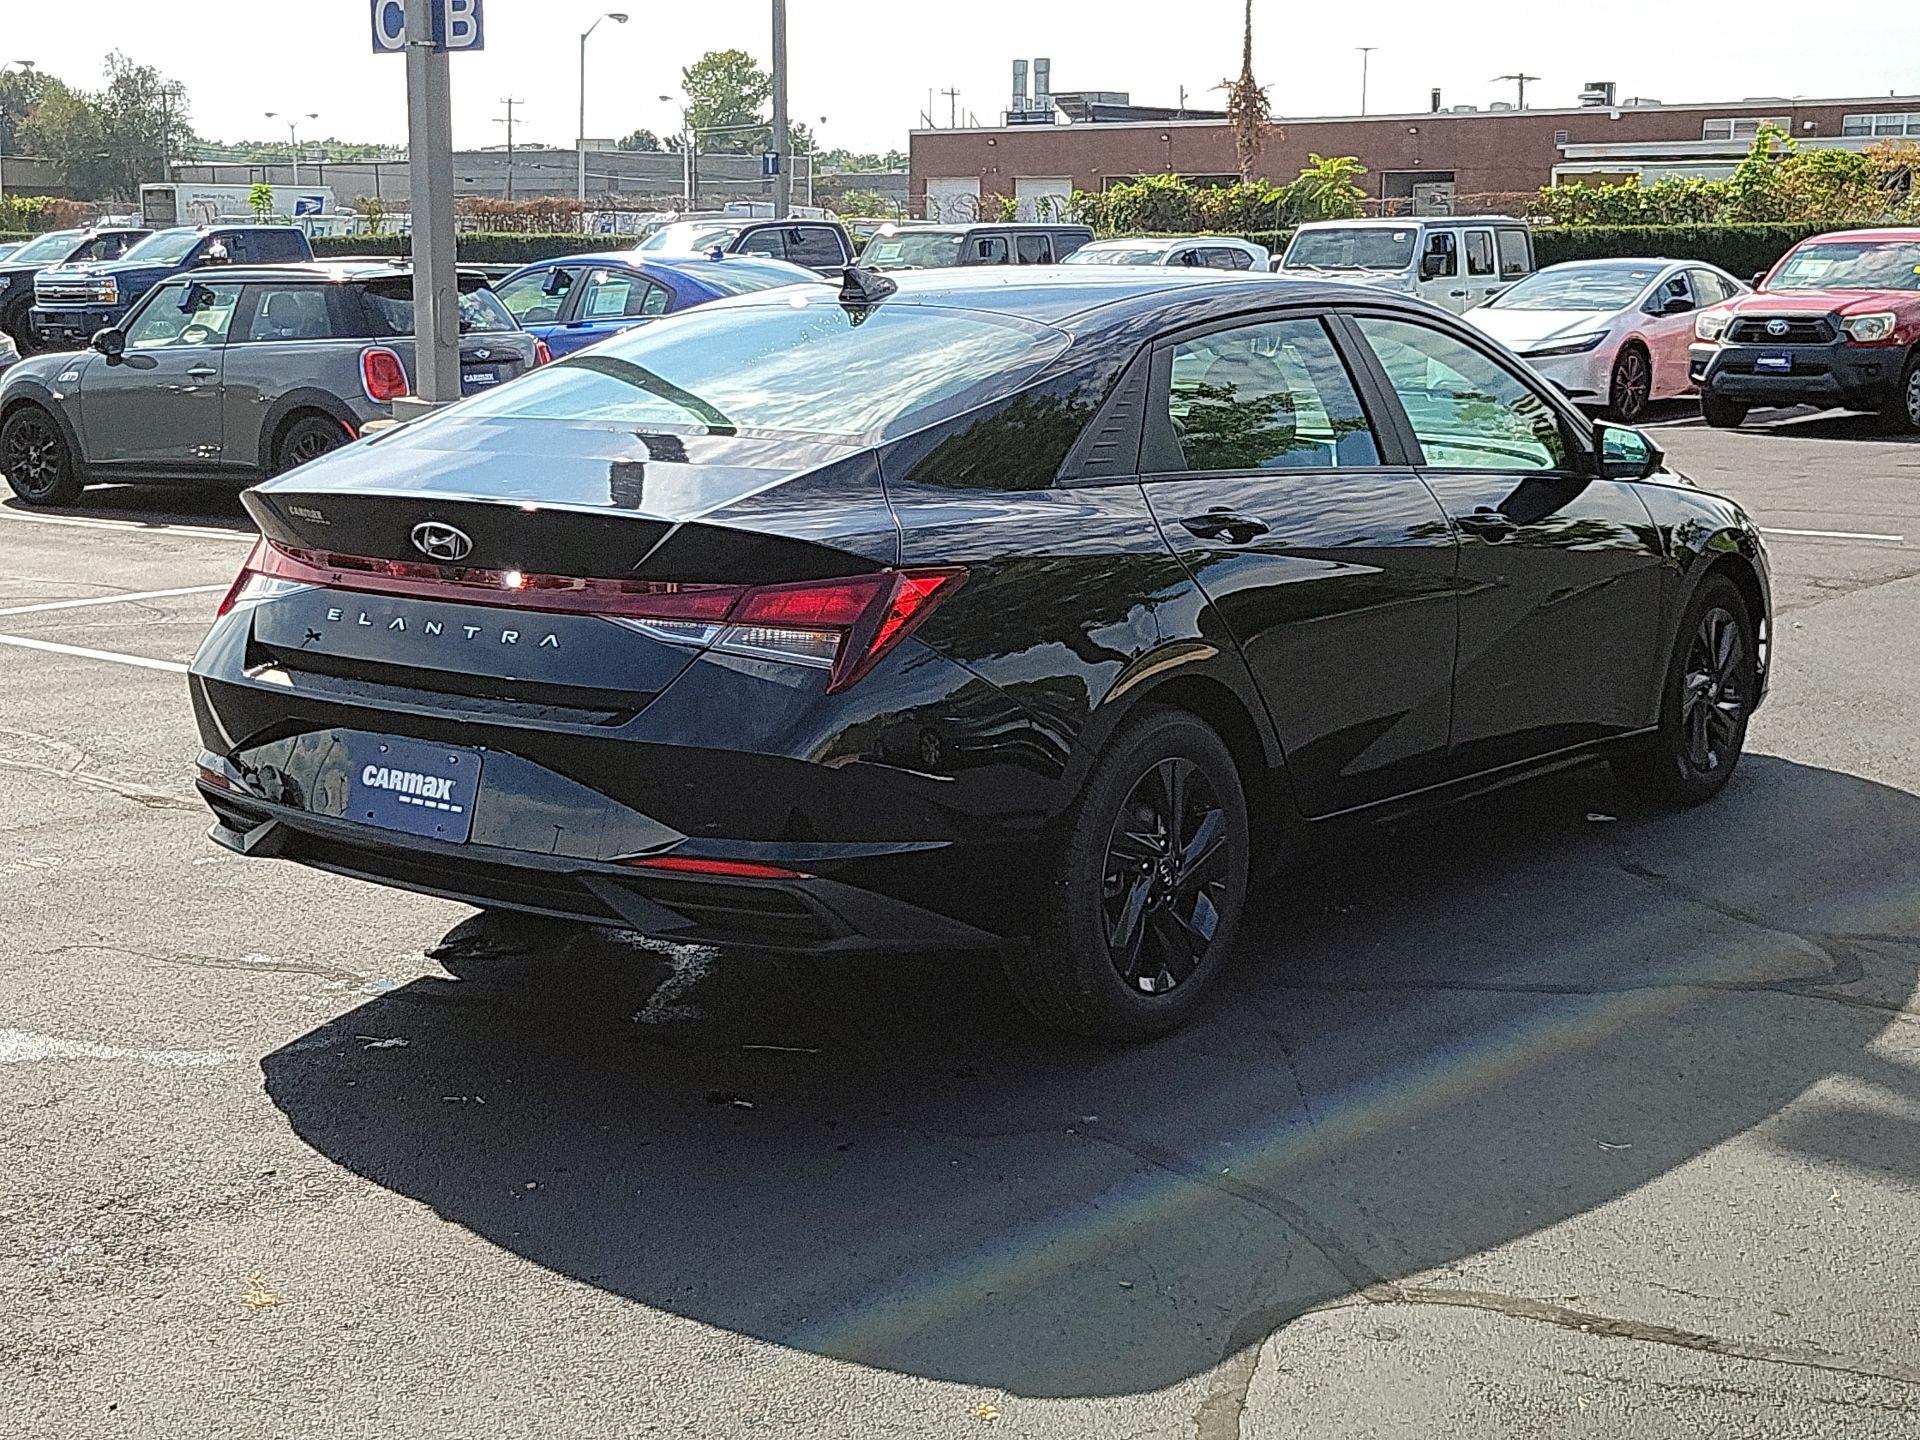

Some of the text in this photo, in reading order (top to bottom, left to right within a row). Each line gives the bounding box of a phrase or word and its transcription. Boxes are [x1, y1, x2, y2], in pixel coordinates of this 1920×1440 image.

[376, 0, 405, 49] C
[445, 0, 477, 47] B
[765, 153, 777, 173] T
[327, 609, 560, 648] ELANTRA
